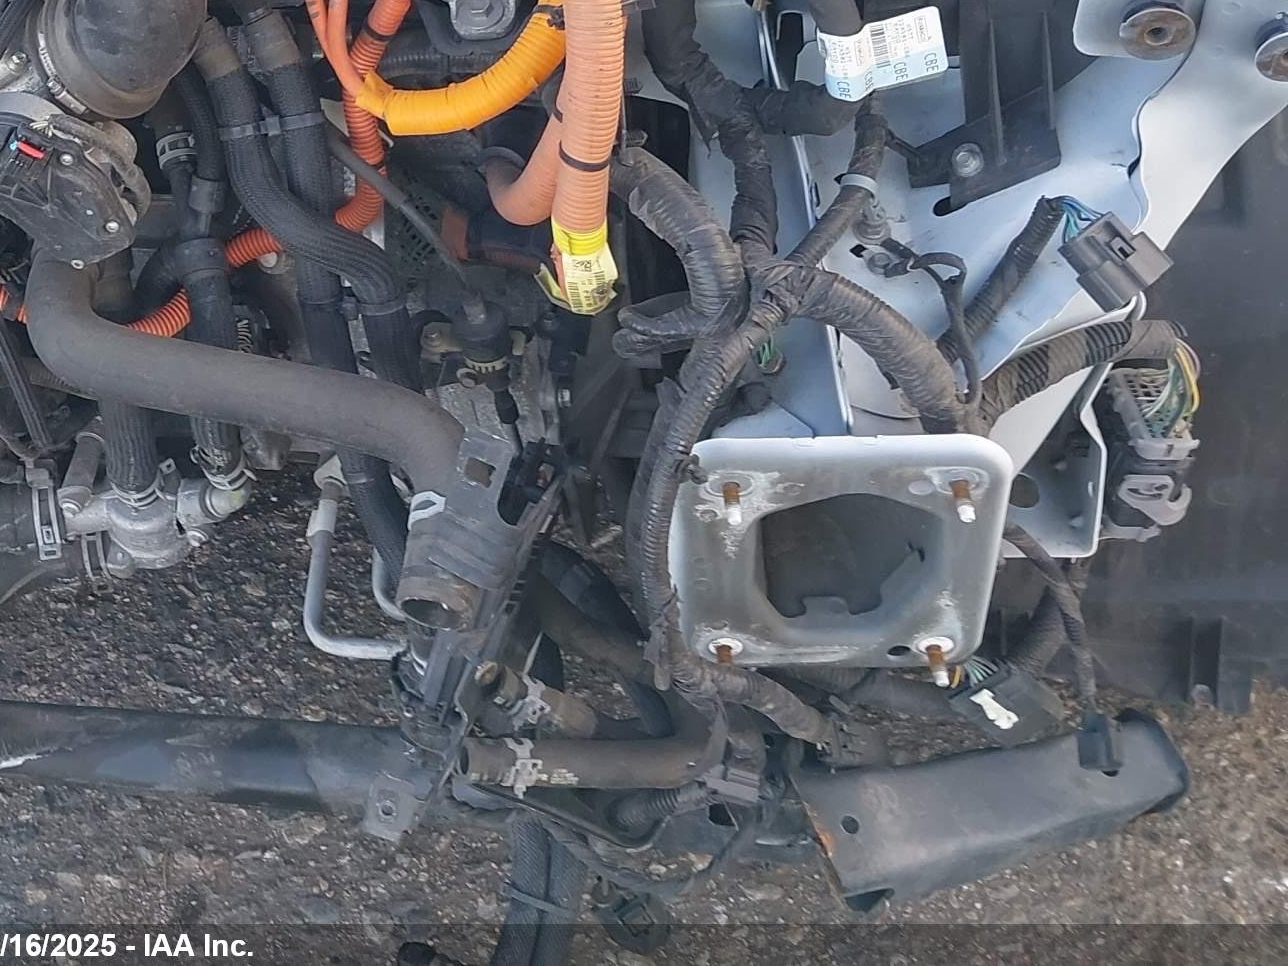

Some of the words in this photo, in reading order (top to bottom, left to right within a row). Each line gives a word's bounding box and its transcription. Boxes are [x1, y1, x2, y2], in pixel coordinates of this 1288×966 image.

[893, 61, 909, 81] CBE
[924, 52, 939, 73] CBE
[837, 81, 852, 99] CBE
